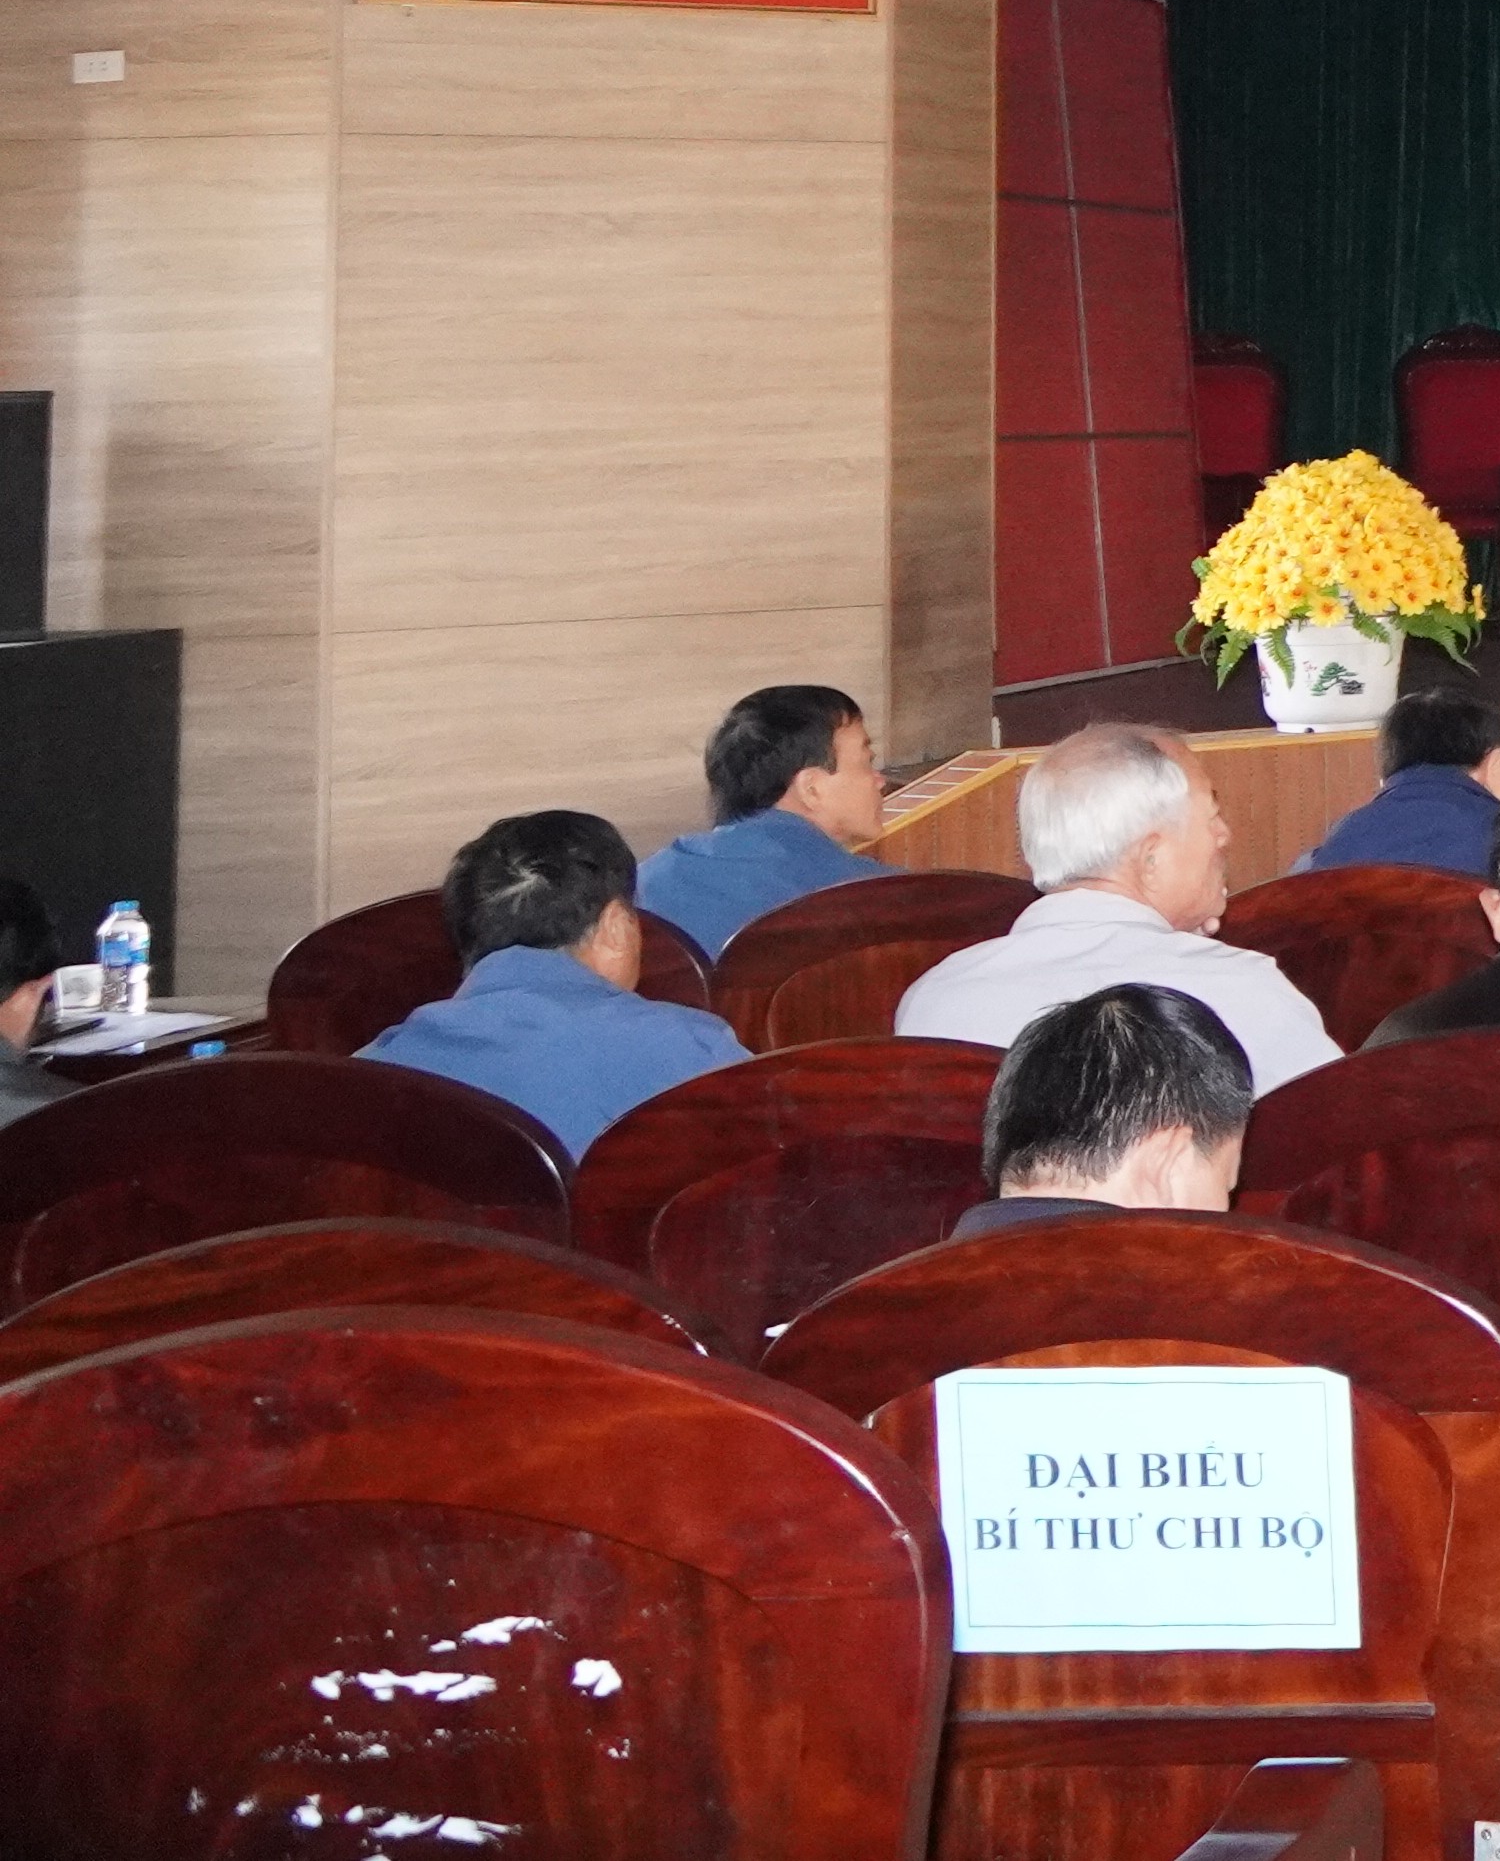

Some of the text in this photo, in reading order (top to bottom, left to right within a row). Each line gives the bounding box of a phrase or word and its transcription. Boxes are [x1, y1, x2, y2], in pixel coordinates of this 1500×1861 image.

[1023, 1440, 1264, 1499] ĐẠI BIỂU
[973, 1507, 1324, 1558] BÍ THƯ CHI BỘ
